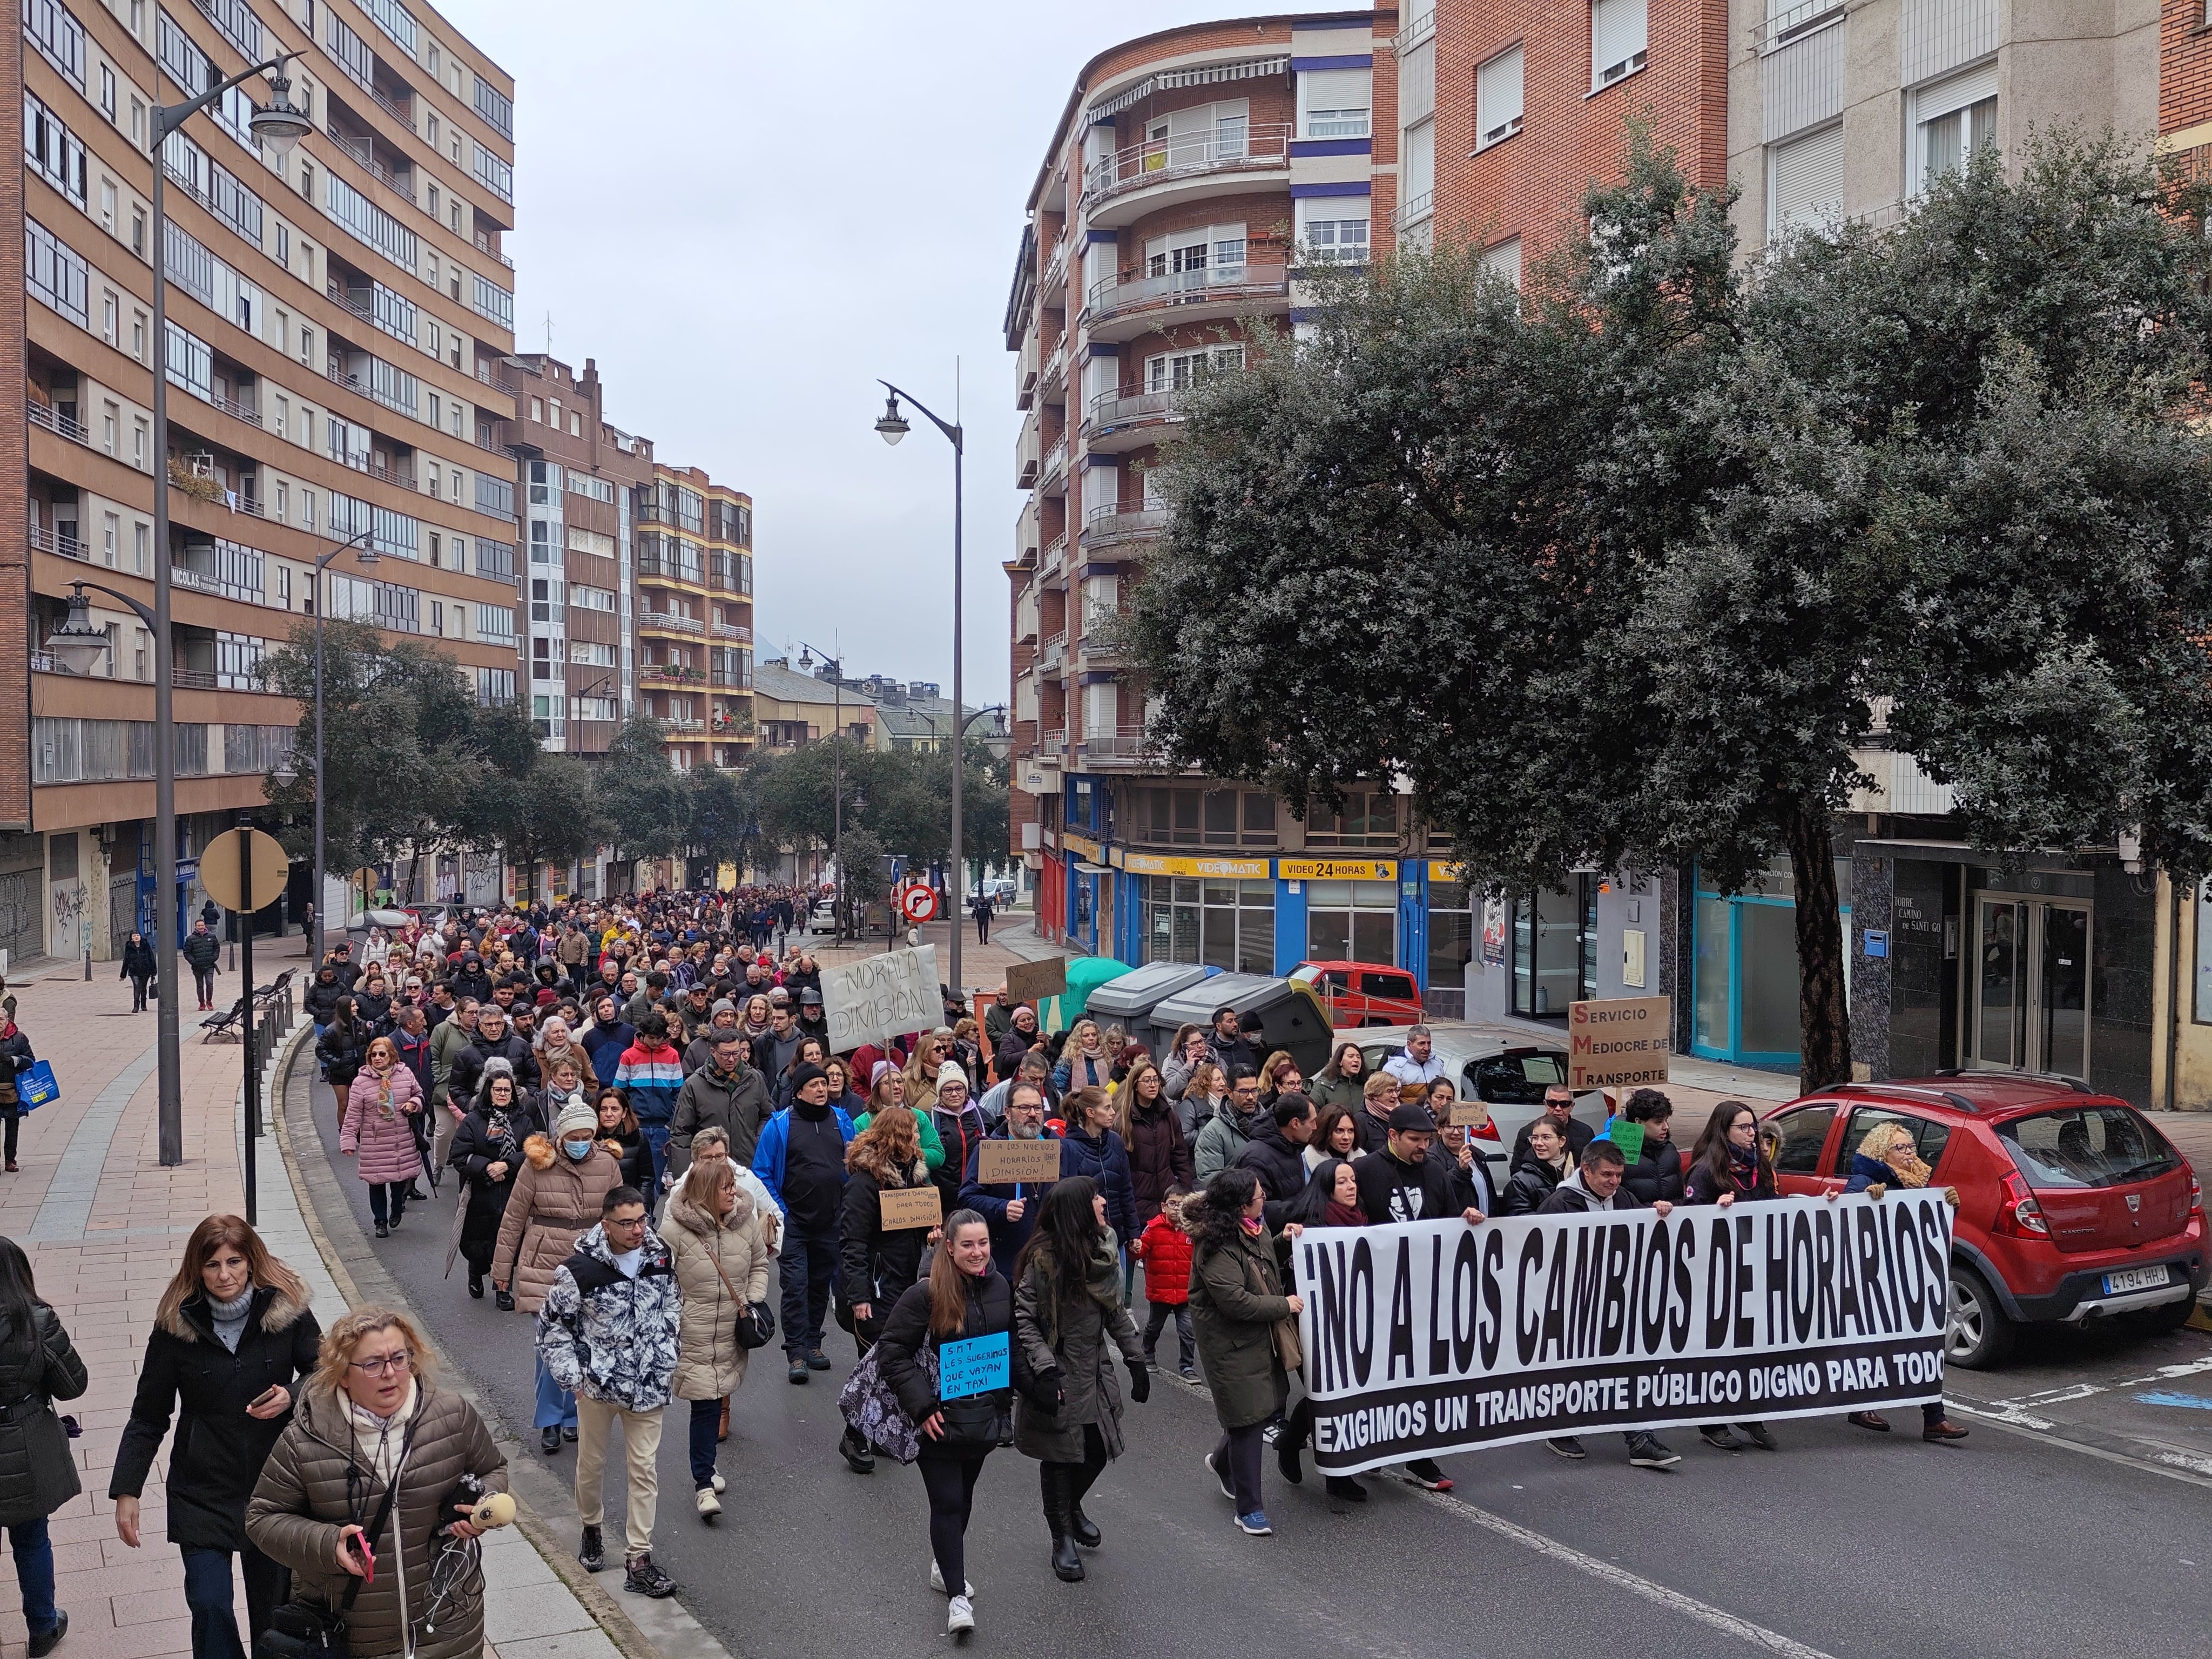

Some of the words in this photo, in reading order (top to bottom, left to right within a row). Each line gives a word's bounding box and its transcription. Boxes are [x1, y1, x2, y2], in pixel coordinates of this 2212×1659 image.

[1128, 858, 1164, 872] VIDEOMATIC
[1171, 859, 1188, 870] 24
[1196, 861, 1262, 876] VIDEOMATIC
[1287, 865, 1313, 874] VIDEO
[1316, 862, 1334, 877] 24
[1335, 865, 1366, 875] HORAS
[1894, 896, 1913, 907] TORRE
[1898, 908, 1921, 919] CAMINO
[1911, 920, 1941, 933] SANTIGO
[846, 951, 921, 994] MORALA
[830, 985, 926, 1039] DIMISIÓN
[1574, 1004, 1647, 1023] SERVICIO
[1574, 1035, 1648, 1055] MEDIOCRE
[1653, 1038, 1668, 1050] DE
[1573, 1067, 1664, 1085] TRANSPORTE
[1000, 1155, 1041, 1165] HORARIOS
[896, 1202, 912, 1210] PARA
[2113, 1273, 2142, 1290] 4194
[2145, 1270, 2166, 1285] HHJ
[1304, 1236, 1374, 1393] ¡NO
[1387, 1235, 1415, 1381] A
[1429, 1228, 1504, 1377] LOS
[1514, 1218, 1695, 1367] CAMBIOS
[1705, 1215, 1754, 1350] DE
[945, 1357, 962, 1370] LES
[966, 1348, 1008, 1363] SUGERIMOS
[945, 1371, 964, 1383] QUE
[969, 1361, 1002, 1376] VAYAN
[947, 1384, 960, 1394] EN
[1315, 1399, 1426, 1454] EXIGIMOS
[1434, 1393, 1468, 1432] UN
[1476, 1375, 1630, 1421] TRANSPORTE
[1636, 1364, 1743, 1407] PÚBLICO
[1750, 1362, 1819, 1401] DIGNO
[1827, 1357, 1889, 1393] PARA
